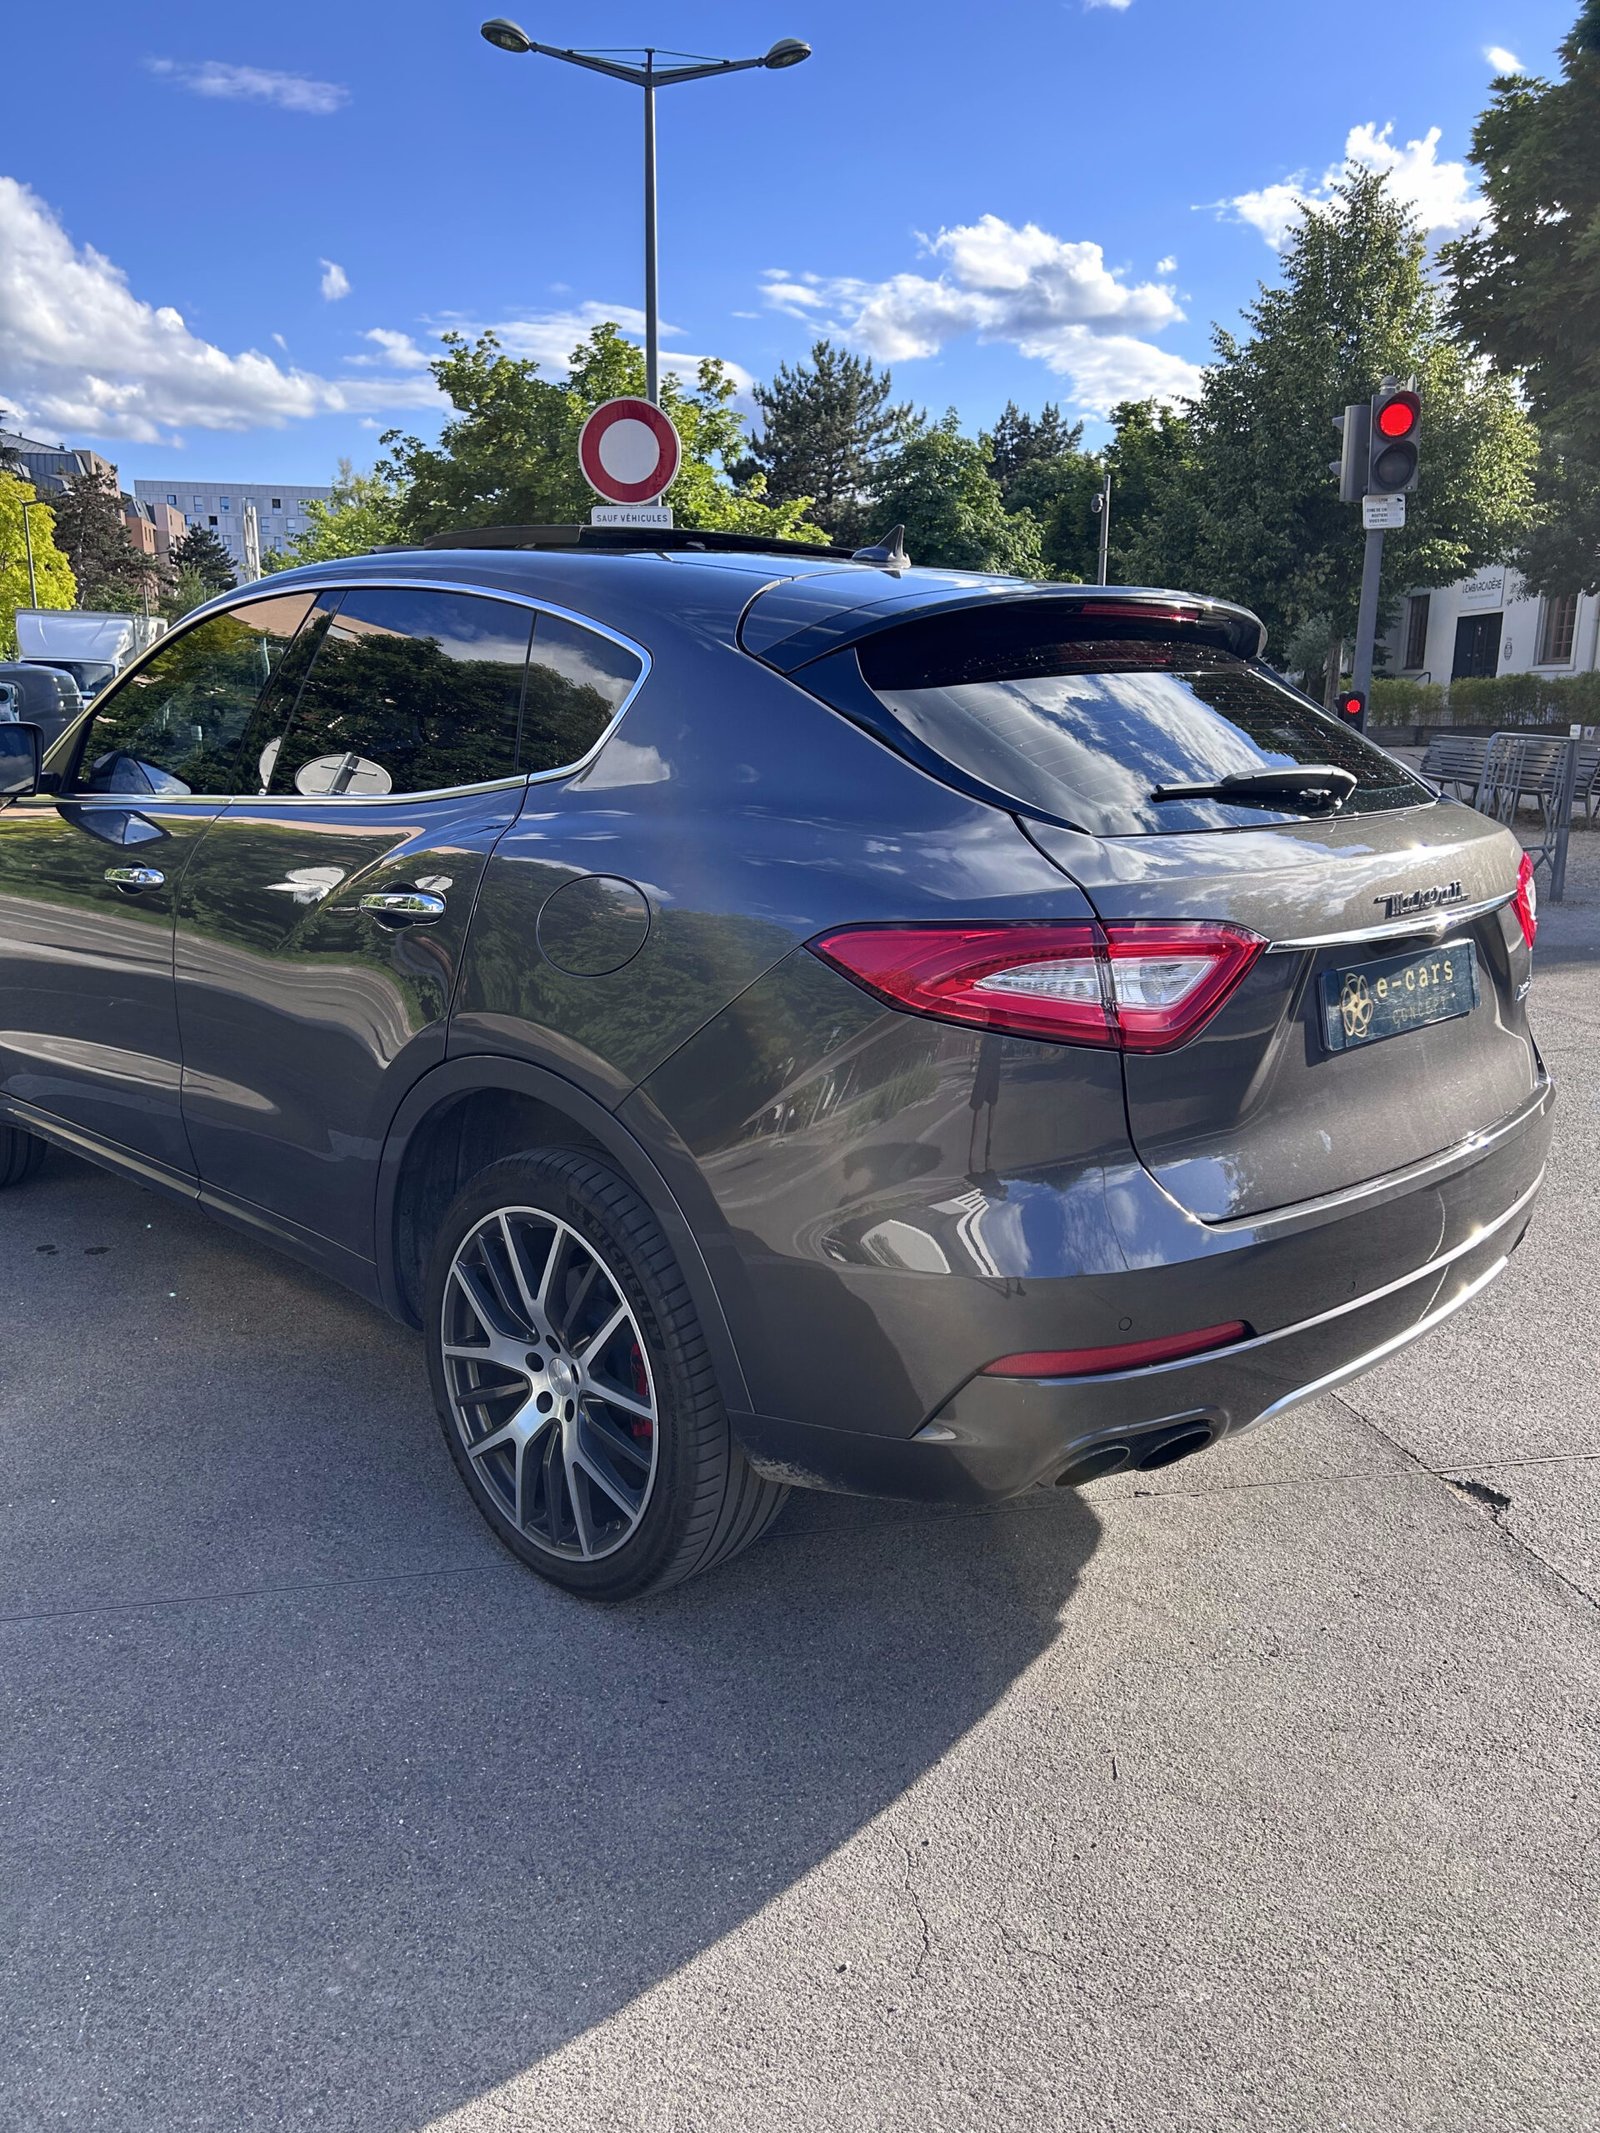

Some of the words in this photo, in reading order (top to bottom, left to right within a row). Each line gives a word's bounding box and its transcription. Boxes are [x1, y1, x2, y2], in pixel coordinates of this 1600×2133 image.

[596, 514, 618, 523] SAUF
[620, 512, 668, 523] VÉHICULES
[1376, 959, 1454, 998] e-cars
[588, 1218, 664, 1345] MICHELIN
